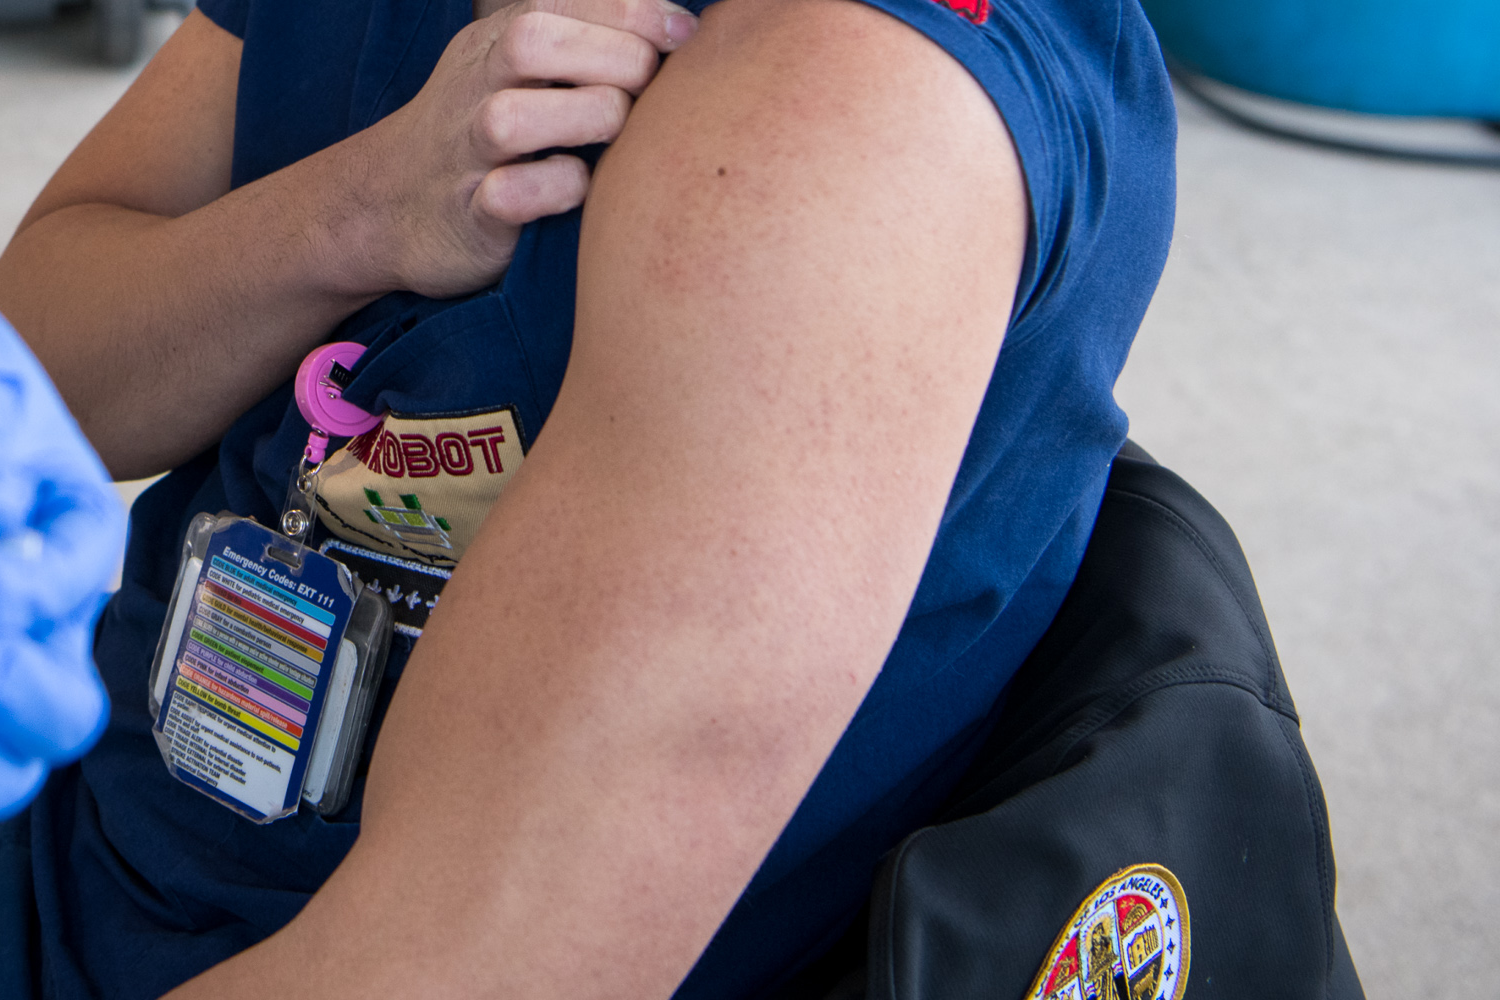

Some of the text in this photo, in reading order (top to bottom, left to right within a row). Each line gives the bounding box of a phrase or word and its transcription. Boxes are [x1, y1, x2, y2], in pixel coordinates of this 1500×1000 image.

[213, 559, 225, 568] CODE
[225, 565, 236, 574] BLUE
[244, 576, 255, 584] adult
[256, 582, 273, 593] medical
[273, 591, 297, 606] emergency
[223, 546, 334, 608] Emergency Codes: EXT 111
[209, 571, 221, 581] CODE
[222, 577, 235, 588] WHITE
[242, 589, 262, 602] pediatric
[262, 600, 279, 611] medical
[280, 609, 304, 625] emergency
[192, 631, 204, 640] CODE
[204, 637, 218, 648] GREEN
[225, 650, 241, 660] patient
[211, 613, 223, 623] GRAY
[234, 626, 255, 641] combative
[256, 638, 271, 649] person
[215, 601, 226, 610] GOLD
[234, 612, 249, 622] mental
[249, 619, 287, 642] health/behavioral
[287, 640, 307, 653] response
[185, 655, 197, 665] CODE
[197, 662, 208, 671] PINK
[215, 671, 227, 682] infant
[228, 680, 249, 694] abduction
[189, 643, 200, 653] CODE
[200, 649, 217, 662] PURPLE
[224, 663, 236, 672] child
[236, 670, 257, 684] abduction
[178, 679, 190, 689] CODE
[191, 686, 207, 698] YELLOW
[215, 699, 227, 710] bomb
[227, 707, 241, 718] threat
[194, 674, 211, 687] ORANGE
[241, 701, 260, 714] material
[169, 714, 182, 724] visitors
[191, 726, 199, 734] staff
[171, 707, 181, 716] CODE
[181, 713, 194, 724] ASSIST
[201, 725, 214, 735] urgent
[214, 733, 229, 744] medical
[230, 741, 250, 756] assistance
[174, 693, 184, 702] CODE
[223, 721, 236, 731] urgent
[237, 729, 253, 740] medical
[253, 738, 271, 750] attention
[165, 727, 175, 736] CODE
[175, 733, 189, 744] TRIAGE
[189, 741, 208, 755] INTERNAL
[214, 756, 229, 767] internal
[230, 765, 246, 777] disaster
[167, 720, 177, 729] CODE
[177, 726, 191, 737] TRIAGE
[191, 734, 203, 744] ALERT
[210, 746, 227, 757] potential
[227, 755, 243, 767] disaster
[171, 747, 186, 759] STROKE
[186, 756, 209, 772] ACTIVATION
[209, 769, 220, 779] TEAM
[173, 741, 187, 751] TRIAGE
[187, 749, 206, 762] EXTERNAL
[213, 765, 229, 776] external
[230, 773, 246, 785] disaster
[197, 772, 218, 787] Emergency
[1093, 885, 1117, 910] LOS
[1117, 876, 1164, 900] ANGELES
